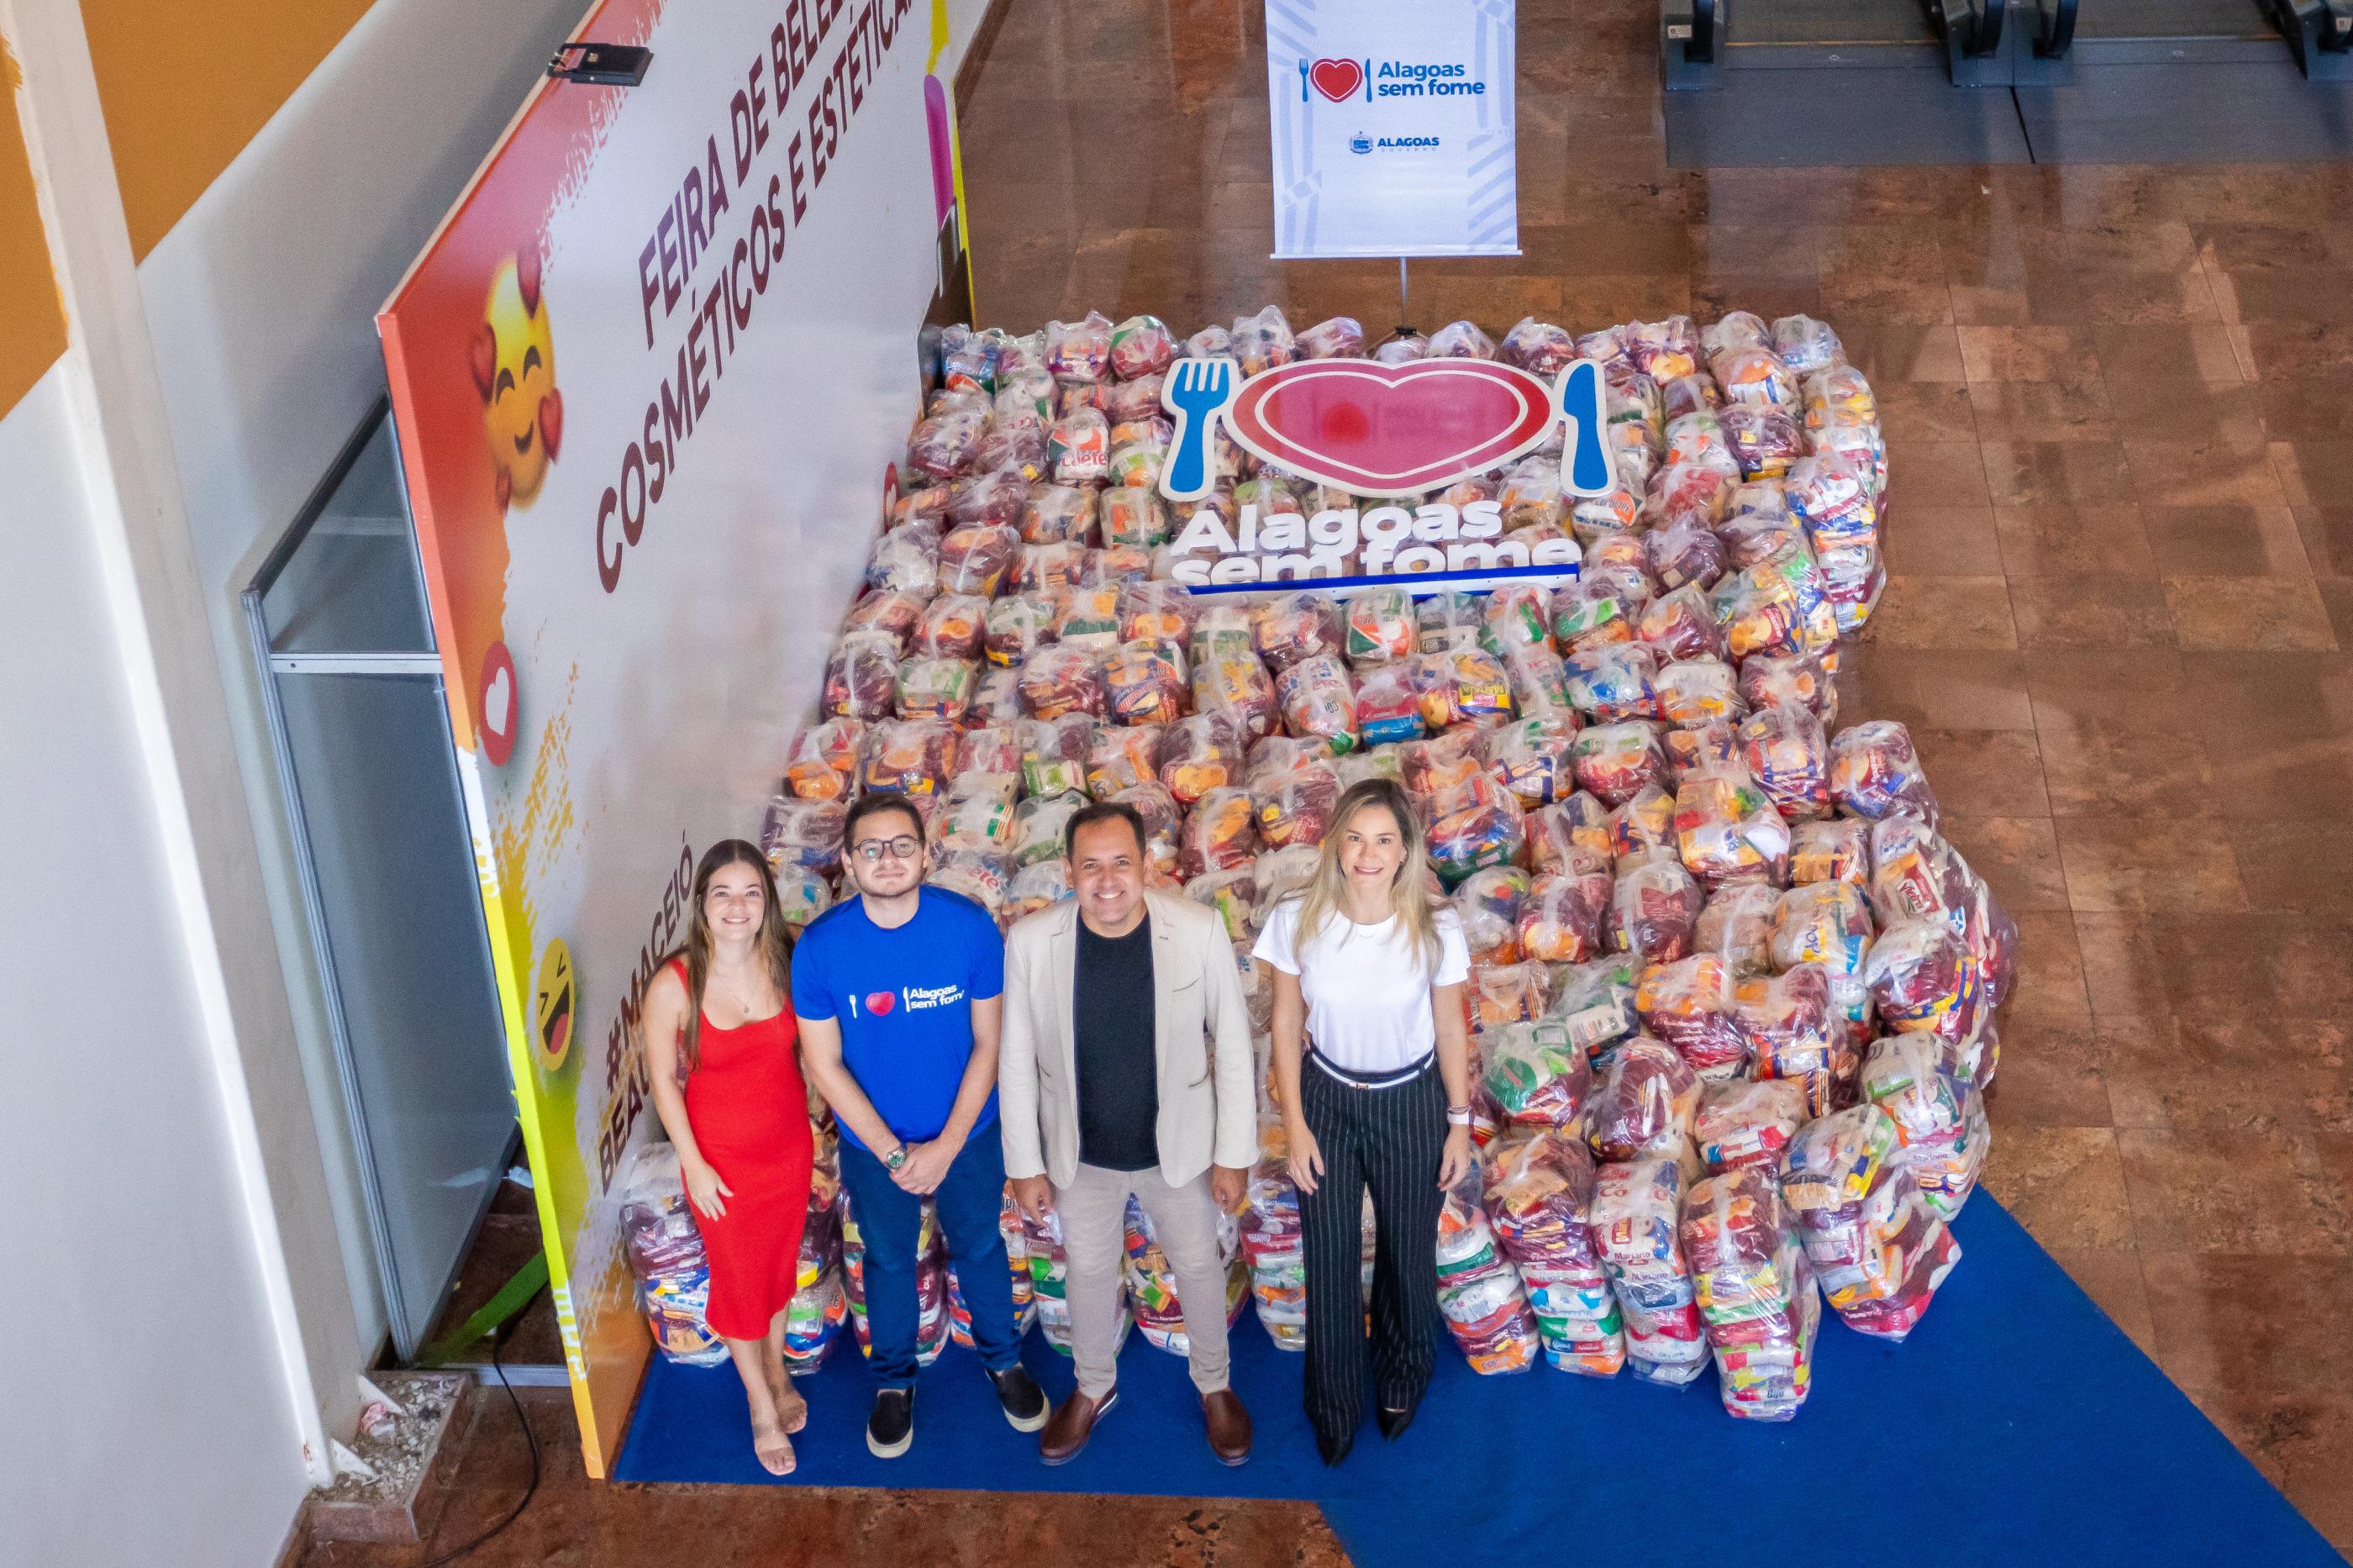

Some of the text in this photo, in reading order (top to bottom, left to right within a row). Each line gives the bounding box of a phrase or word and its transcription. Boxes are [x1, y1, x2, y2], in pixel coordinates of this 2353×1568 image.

[1377, 61, 1466, 82] Alagoas
[1378, 79, 1486, 97] sem fome
[1377, 137, 1440, 147] ALAGOAS
[639, 0, 843, 351] FEIRA DE BELE
[597, 173, 786, 593] COSMÉTICOS
[788, 129, 807, 229] E
[1169, 500, 1503, 558] Alagoas
[1171, 538, 1583, 587] sem fome
[910, 984, 957, 1000] Alagoas
[910, 1000, 937, 1009] sem
